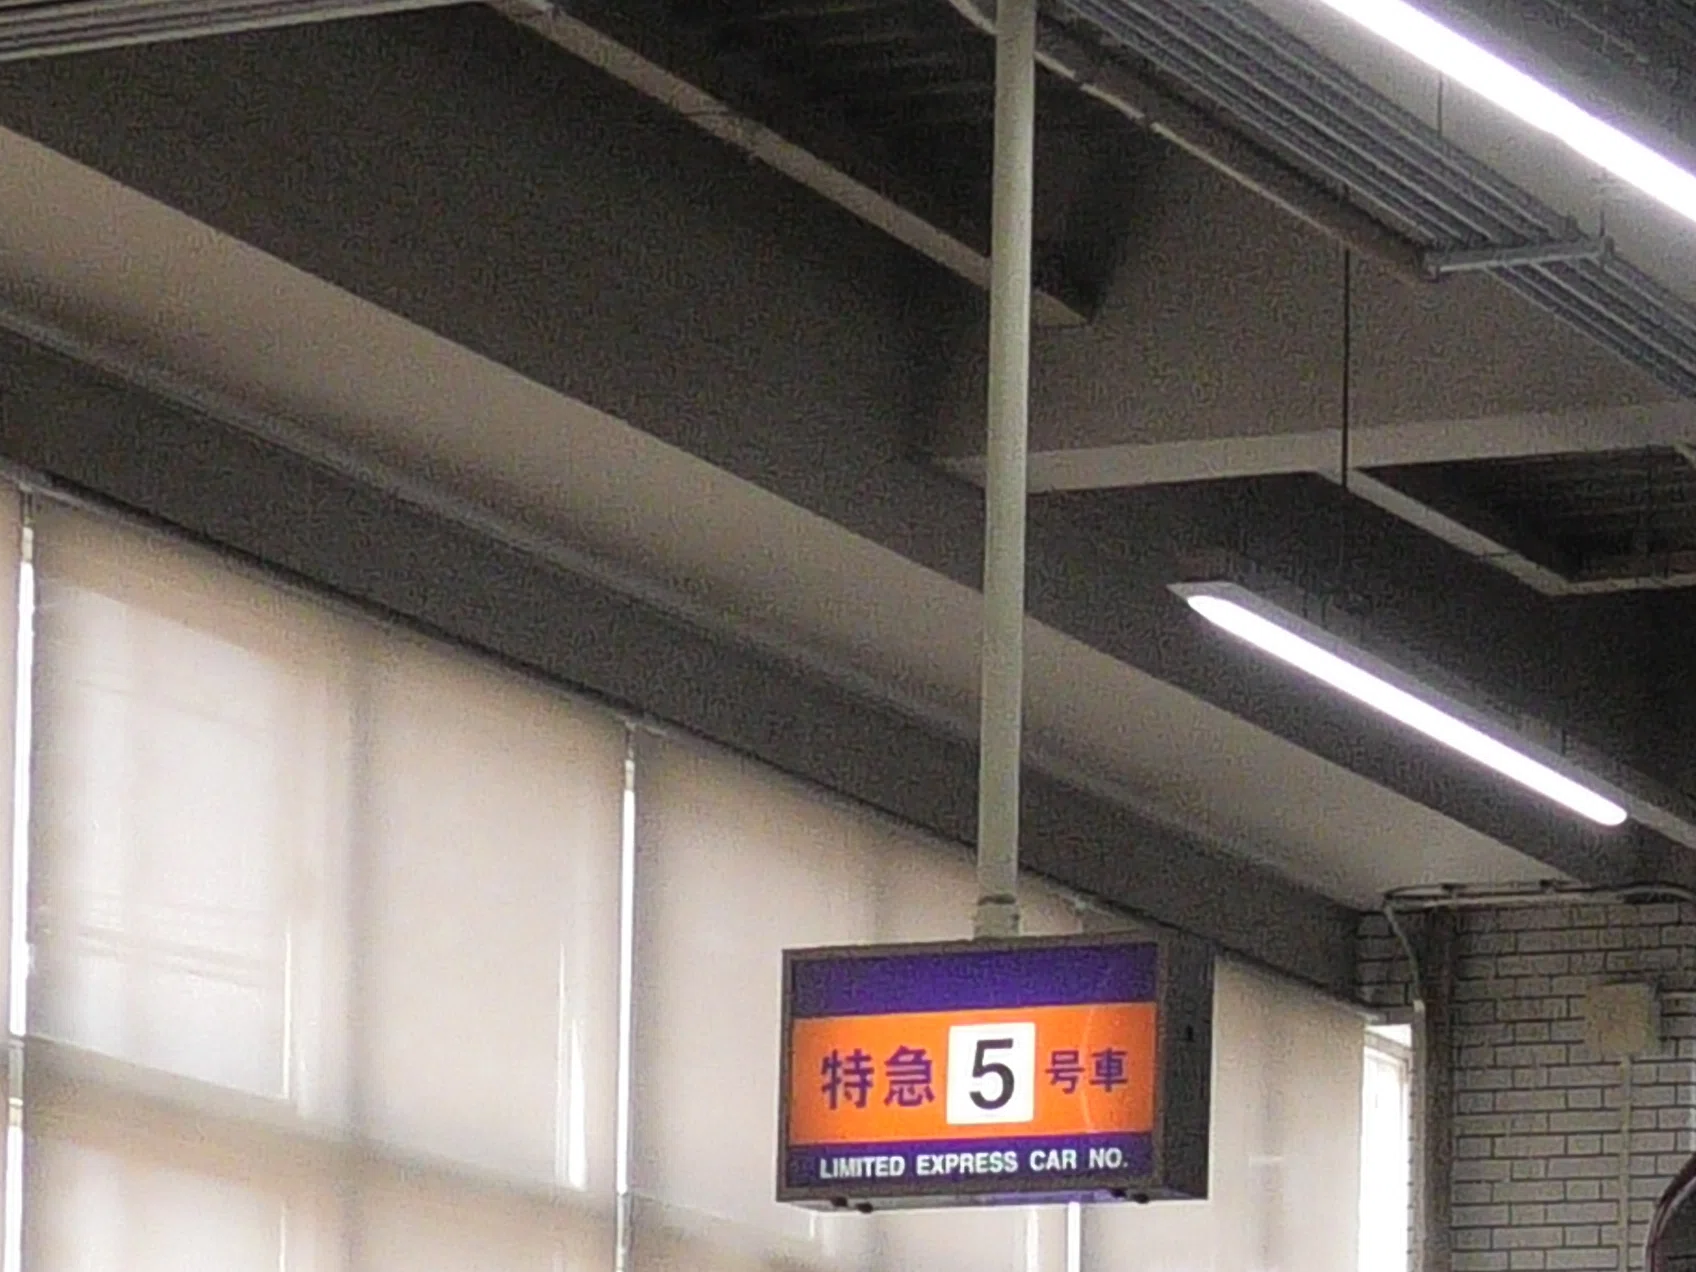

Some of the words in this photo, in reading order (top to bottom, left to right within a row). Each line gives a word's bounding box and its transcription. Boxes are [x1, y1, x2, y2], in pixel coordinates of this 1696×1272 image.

[820, 1045, 936, 1110] 特急
[969, 1037, 1015, 1110] 5
[1045, 1047, 1129, 1095] 号車
[819, 1155, 906, 1179] LIMITED
[916, 1151, 1019, 1176] EXPRESS
[1029, 1148, 1078, 1172] CAR
[1088, 1146, 1129, 1169] NO.
